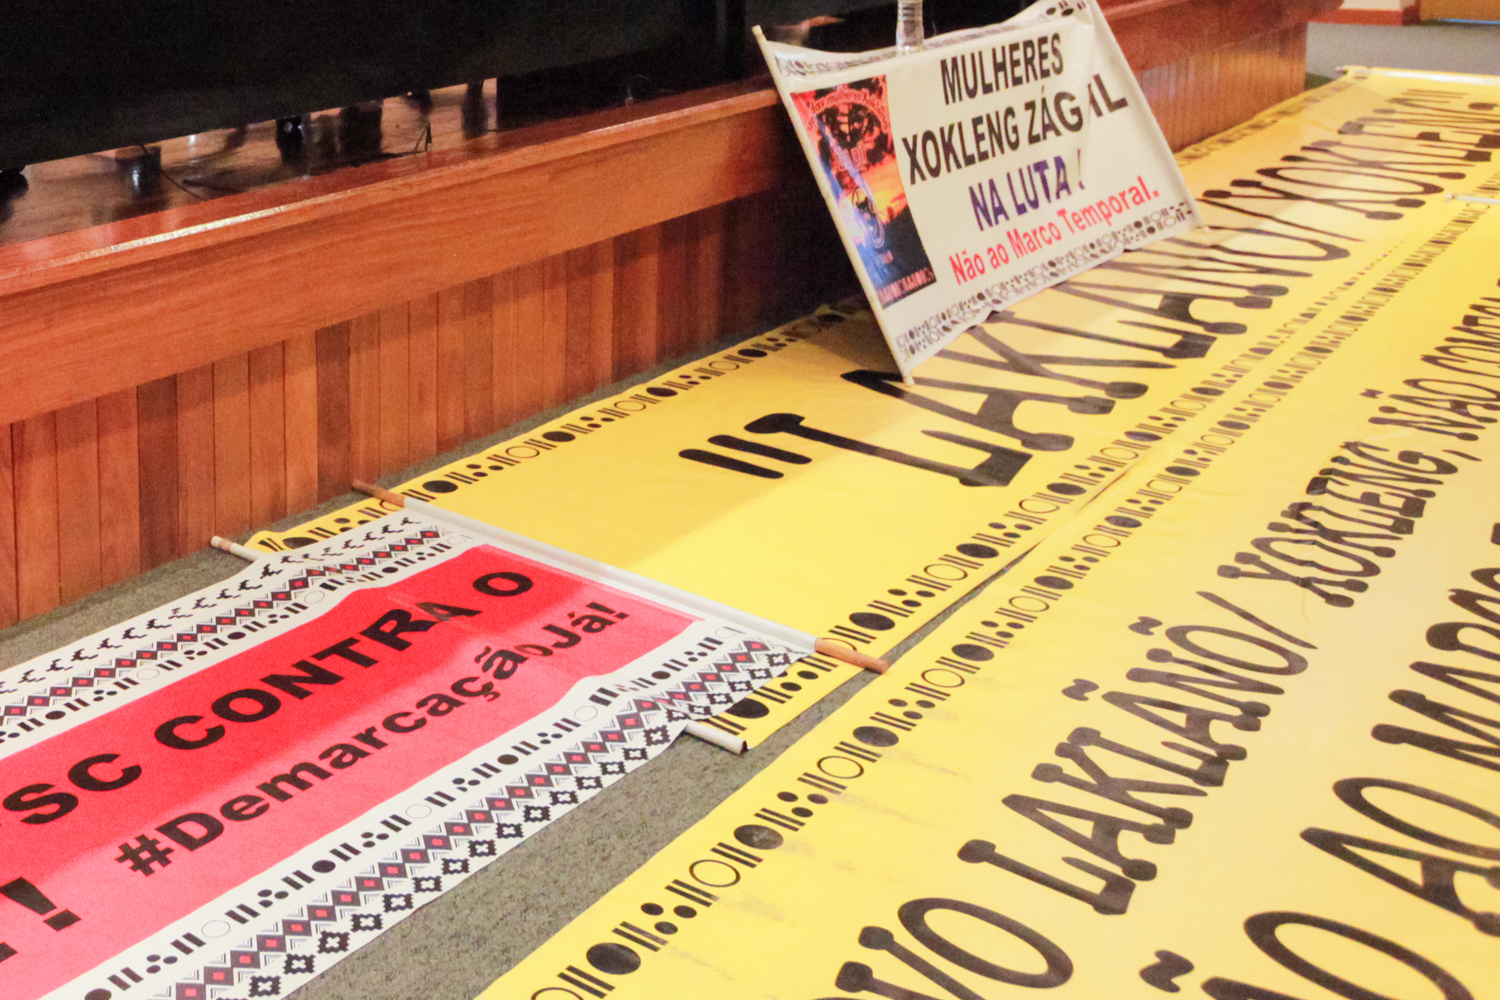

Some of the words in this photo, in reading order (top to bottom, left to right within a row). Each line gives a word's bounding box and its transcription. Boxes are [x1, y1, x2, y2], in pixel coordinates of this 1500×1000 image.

[940, 32, 1064, 106] MULHERES
[901, 106, 1020, 186] XOKLENG
[949, 251, 986, 286] Não
[990, 242, 1010, 272] ao
[1006, 220, 1062, 260] Marco
[1057, 175, 1160, 235] Temporal.
[969, 178, 1010, 232] NA
[154, 601, 482, 750] CONTRA
[472, 570, 534, 598] O
